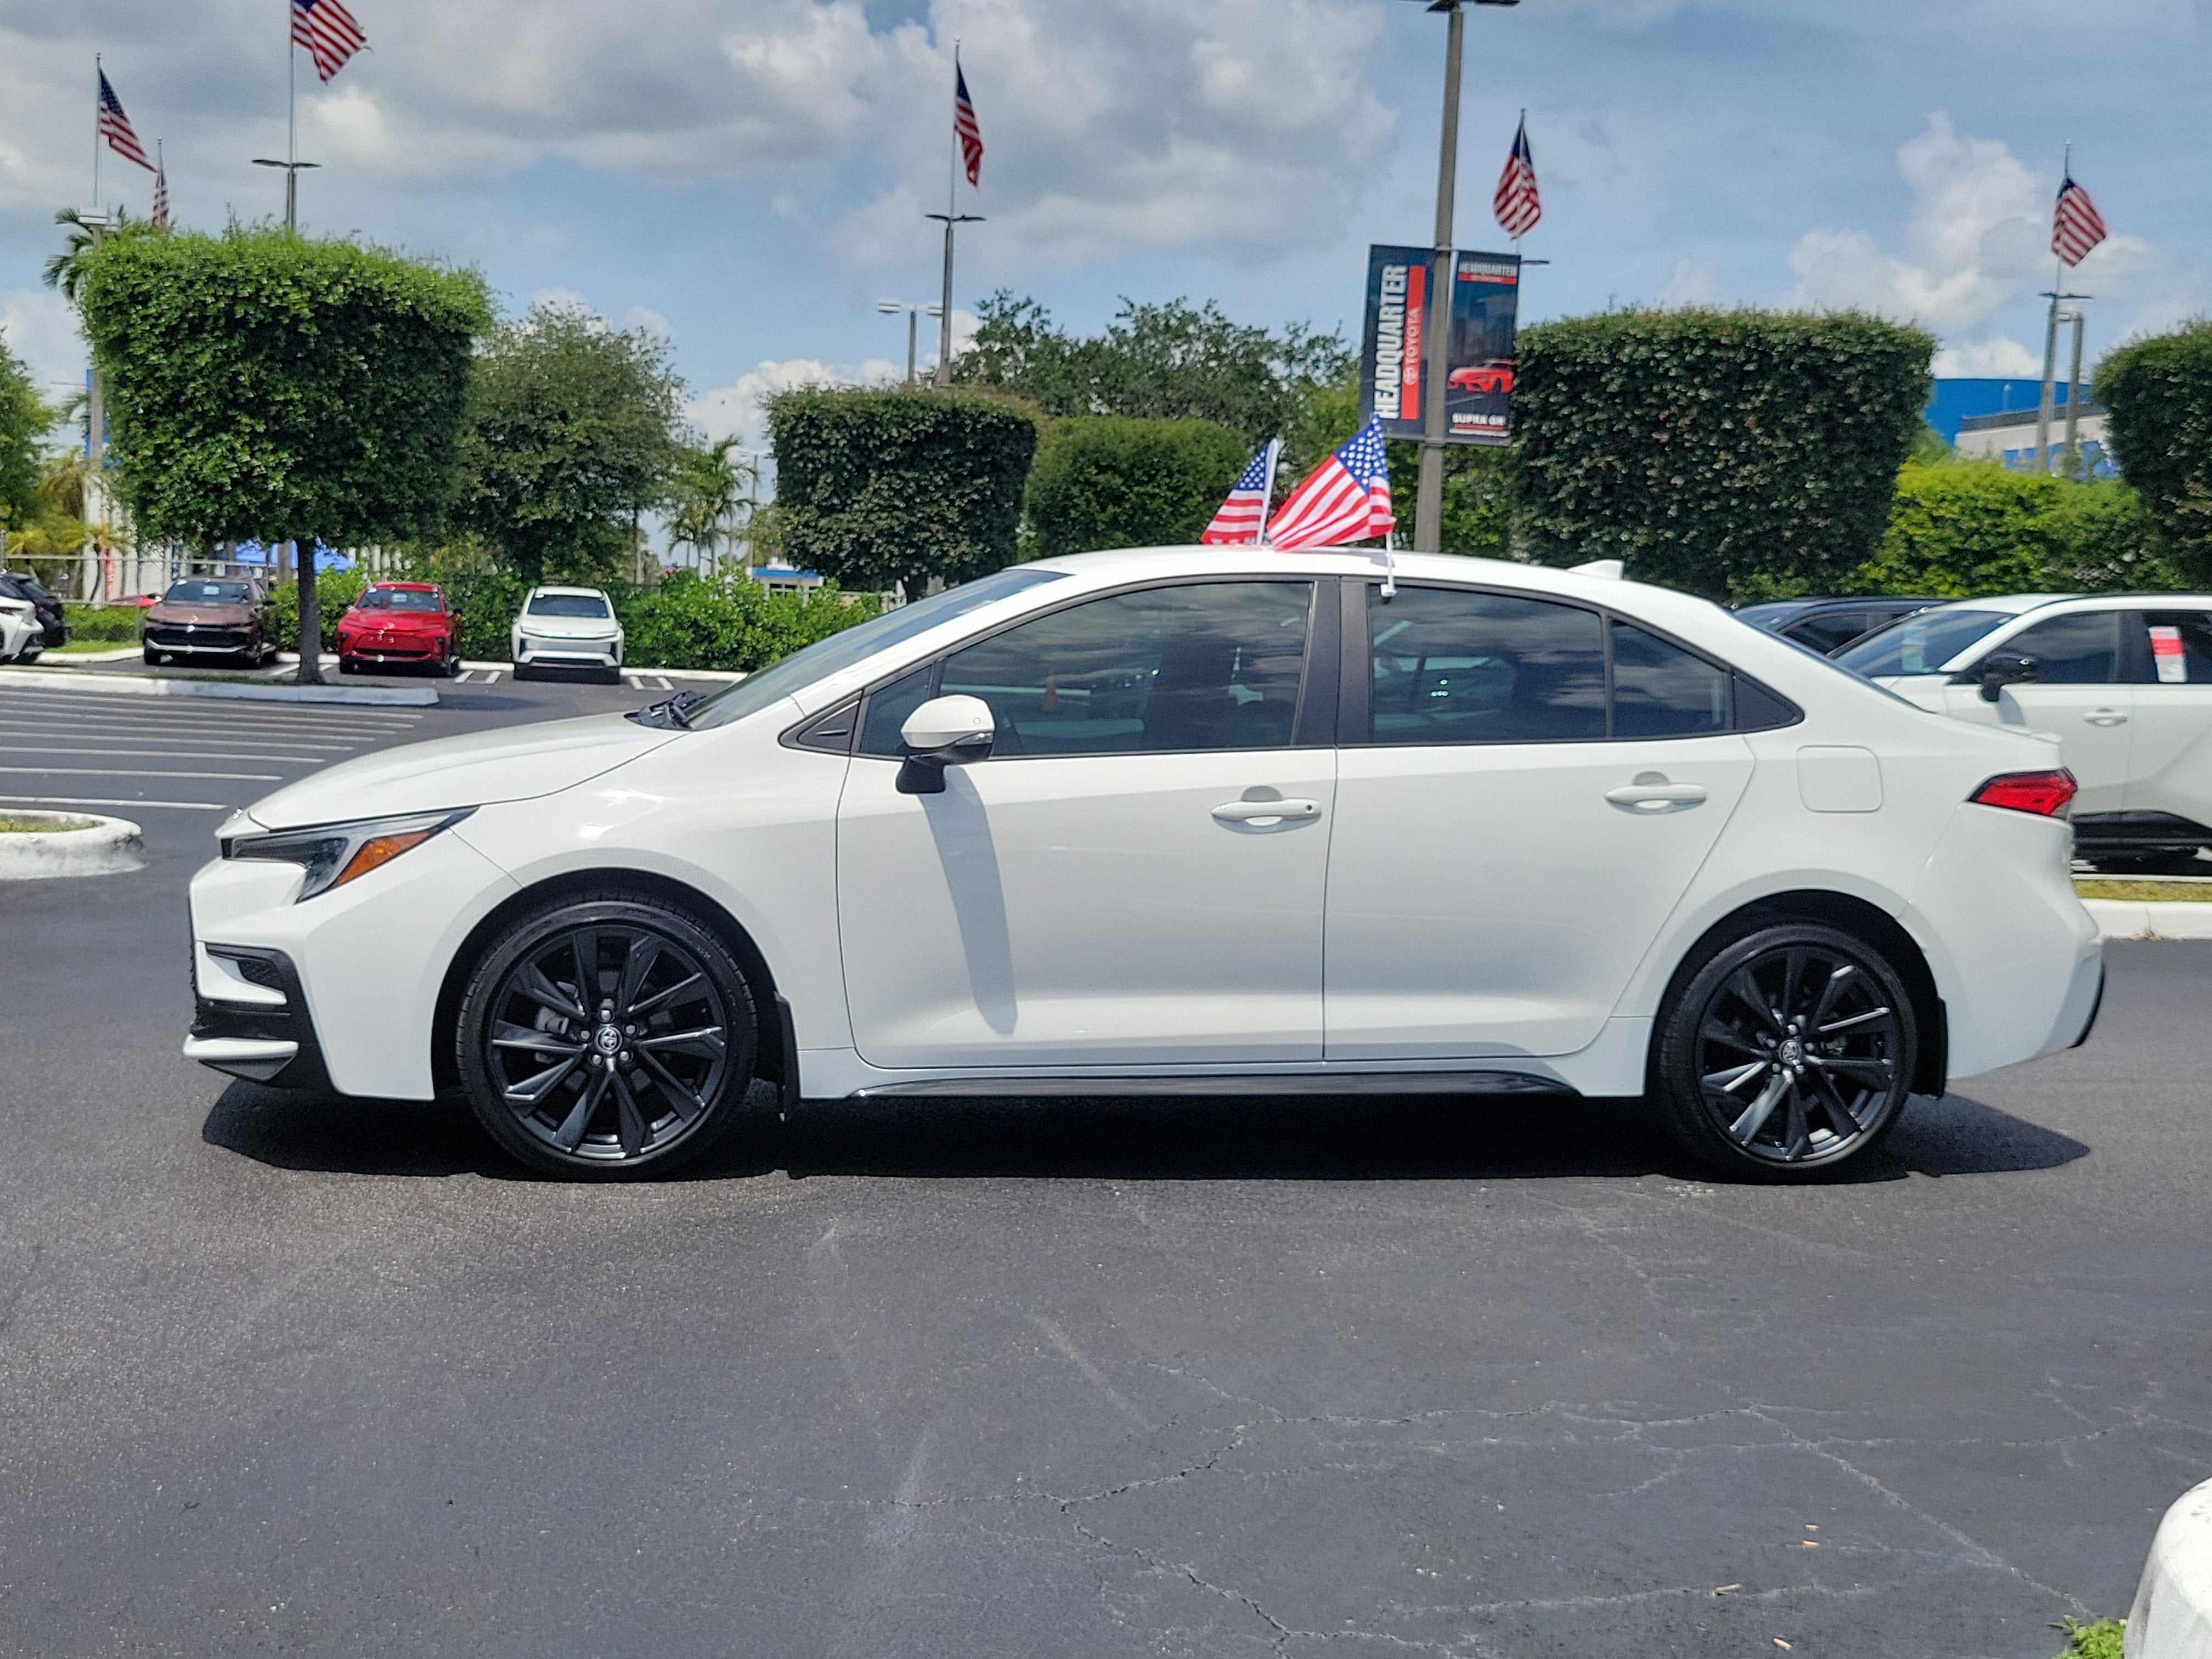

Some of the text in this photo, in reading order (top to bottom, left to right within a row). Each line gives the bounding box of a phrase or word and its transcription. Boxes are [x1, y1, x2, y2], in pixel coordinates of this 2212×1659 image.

[1374, 266, 1407, 419] HEADQUARTER
[1404, 307, 1420, 364] TOYOTA
[1452, 413, 1488, 424] SUPRA
